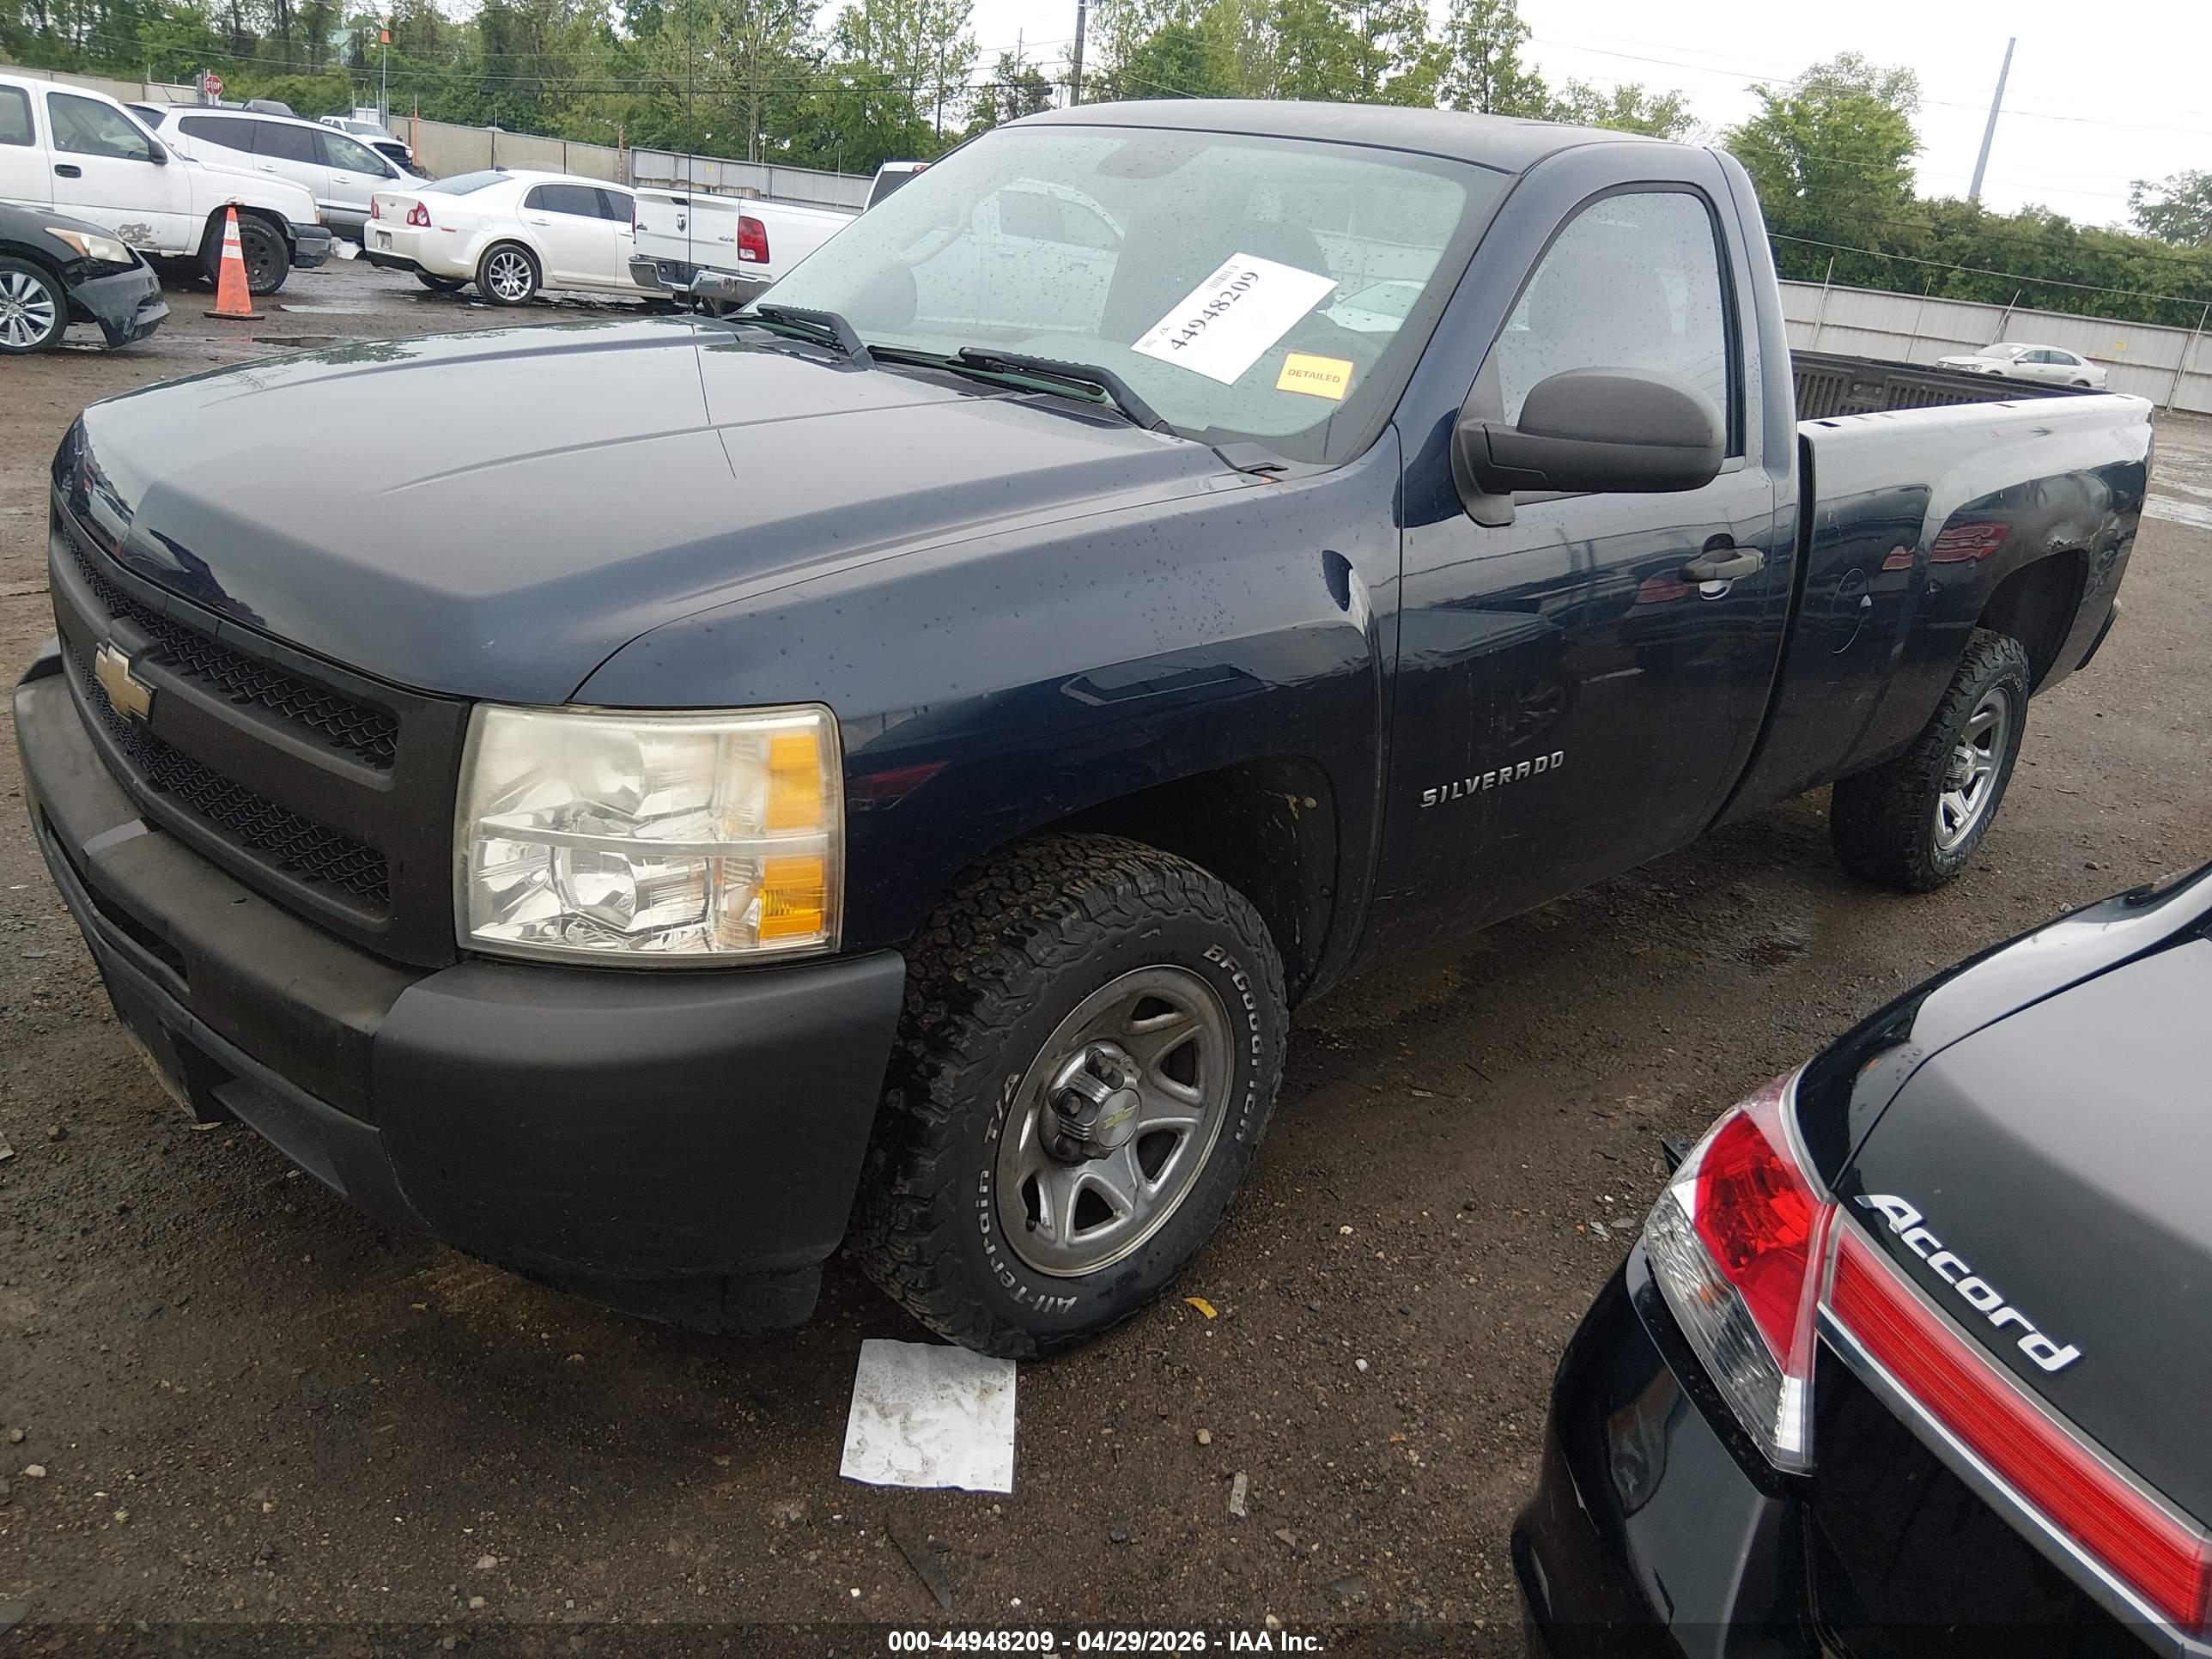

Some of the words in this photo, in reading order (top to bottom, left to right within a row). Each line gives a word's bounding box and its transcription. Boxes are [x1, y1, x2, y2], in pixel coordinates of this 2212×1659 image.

[206, 81, 222, 90] STOP
[1170, 271, 1260, 350] 44948209
[1287, 368, 1340, 383] DETAILED
[1419, 750, 1565, 808] SILVERADO
[1853, 1194, 2081, 1371] Accord
